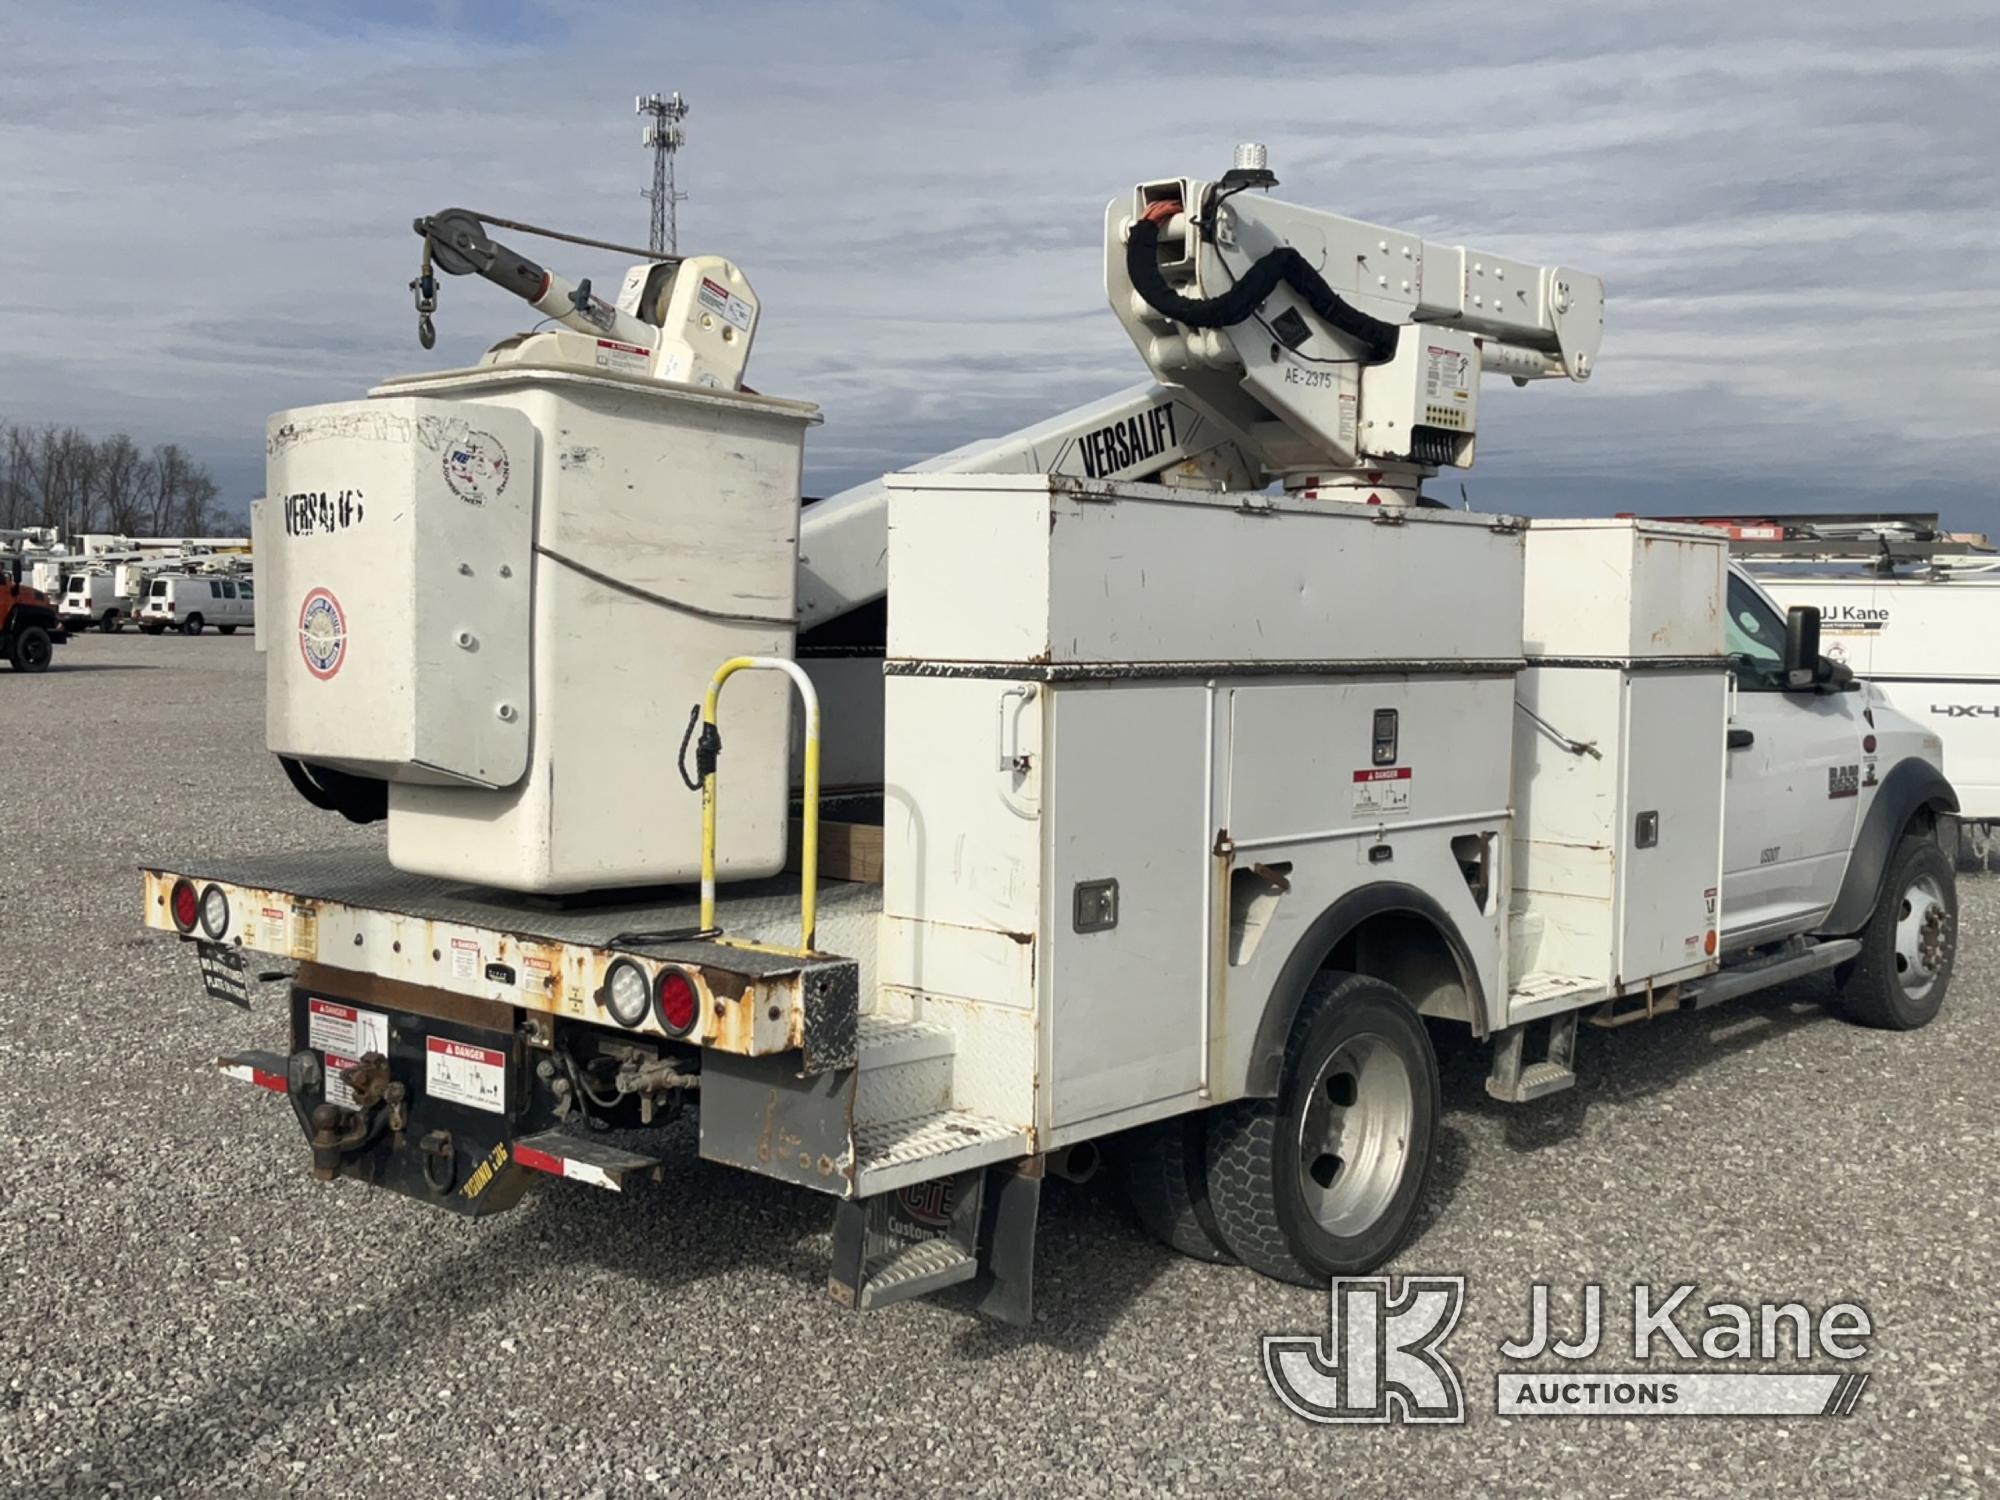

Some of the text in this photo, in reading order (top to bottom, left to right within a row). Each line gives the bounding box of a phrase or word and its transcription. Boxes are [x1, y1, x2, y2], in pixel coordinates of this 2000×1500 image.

[1285, 368, 1332, 389] AE-2375
[1078, 402, 1177, 479] VERSALIFT
[1843, 606, 1889, 620] Kane
[324, 1005, 348, 1017] DANGER
[454, 1045, 485, 1061] DANGER
[888, 1216, 935, 1242] Custom
